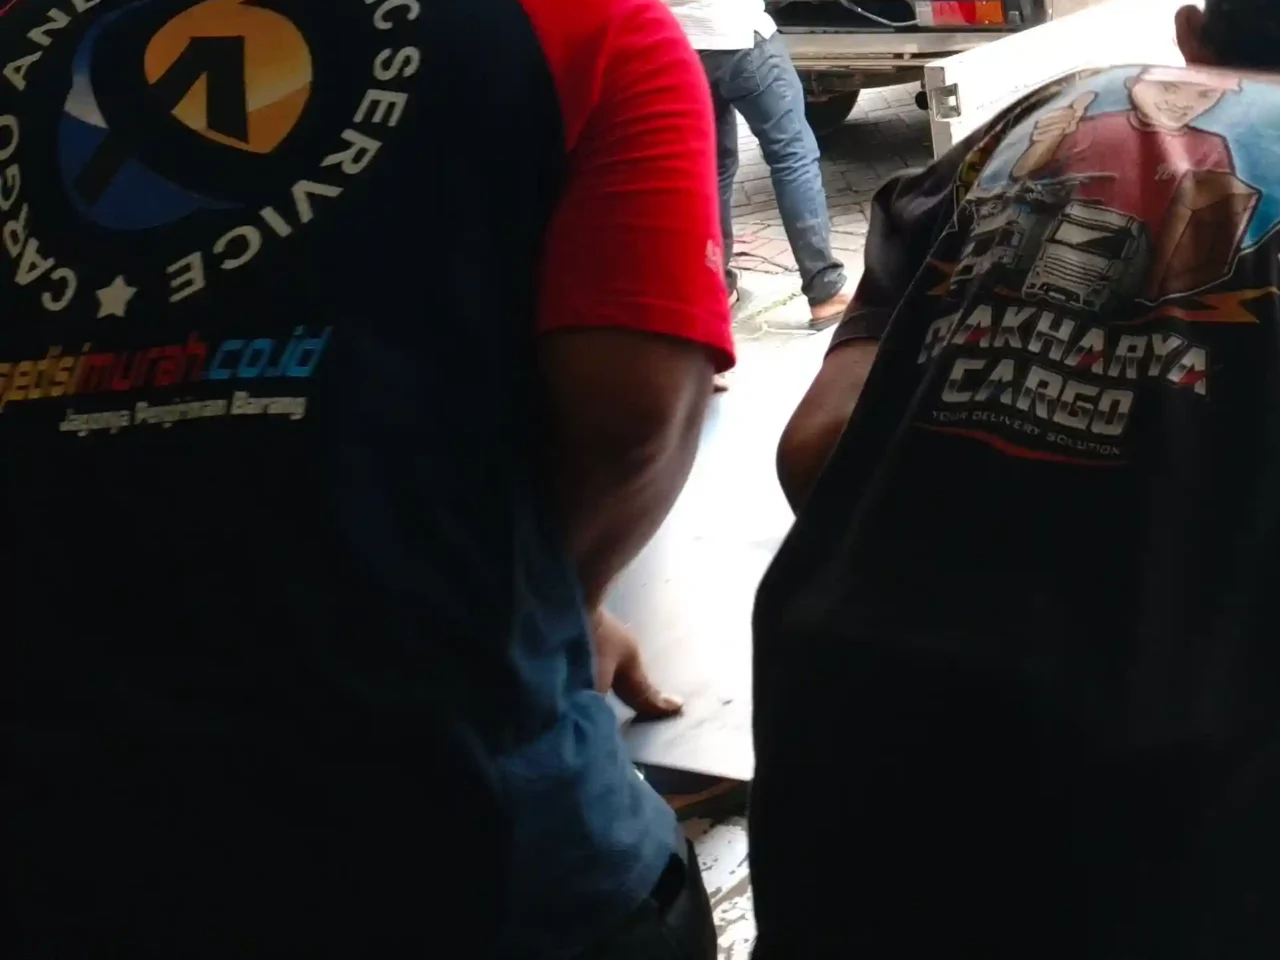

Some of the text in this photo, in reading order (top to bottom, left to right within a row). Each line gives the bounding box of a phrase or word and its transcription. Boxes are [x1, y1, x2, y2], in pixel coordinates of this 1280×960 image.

[166, 45, 421, 303] SERVICE
[931, 409, 1121, 456] YOUR DELIVERY SOLUTION
[940, 357, 1135, 436] CARGO
